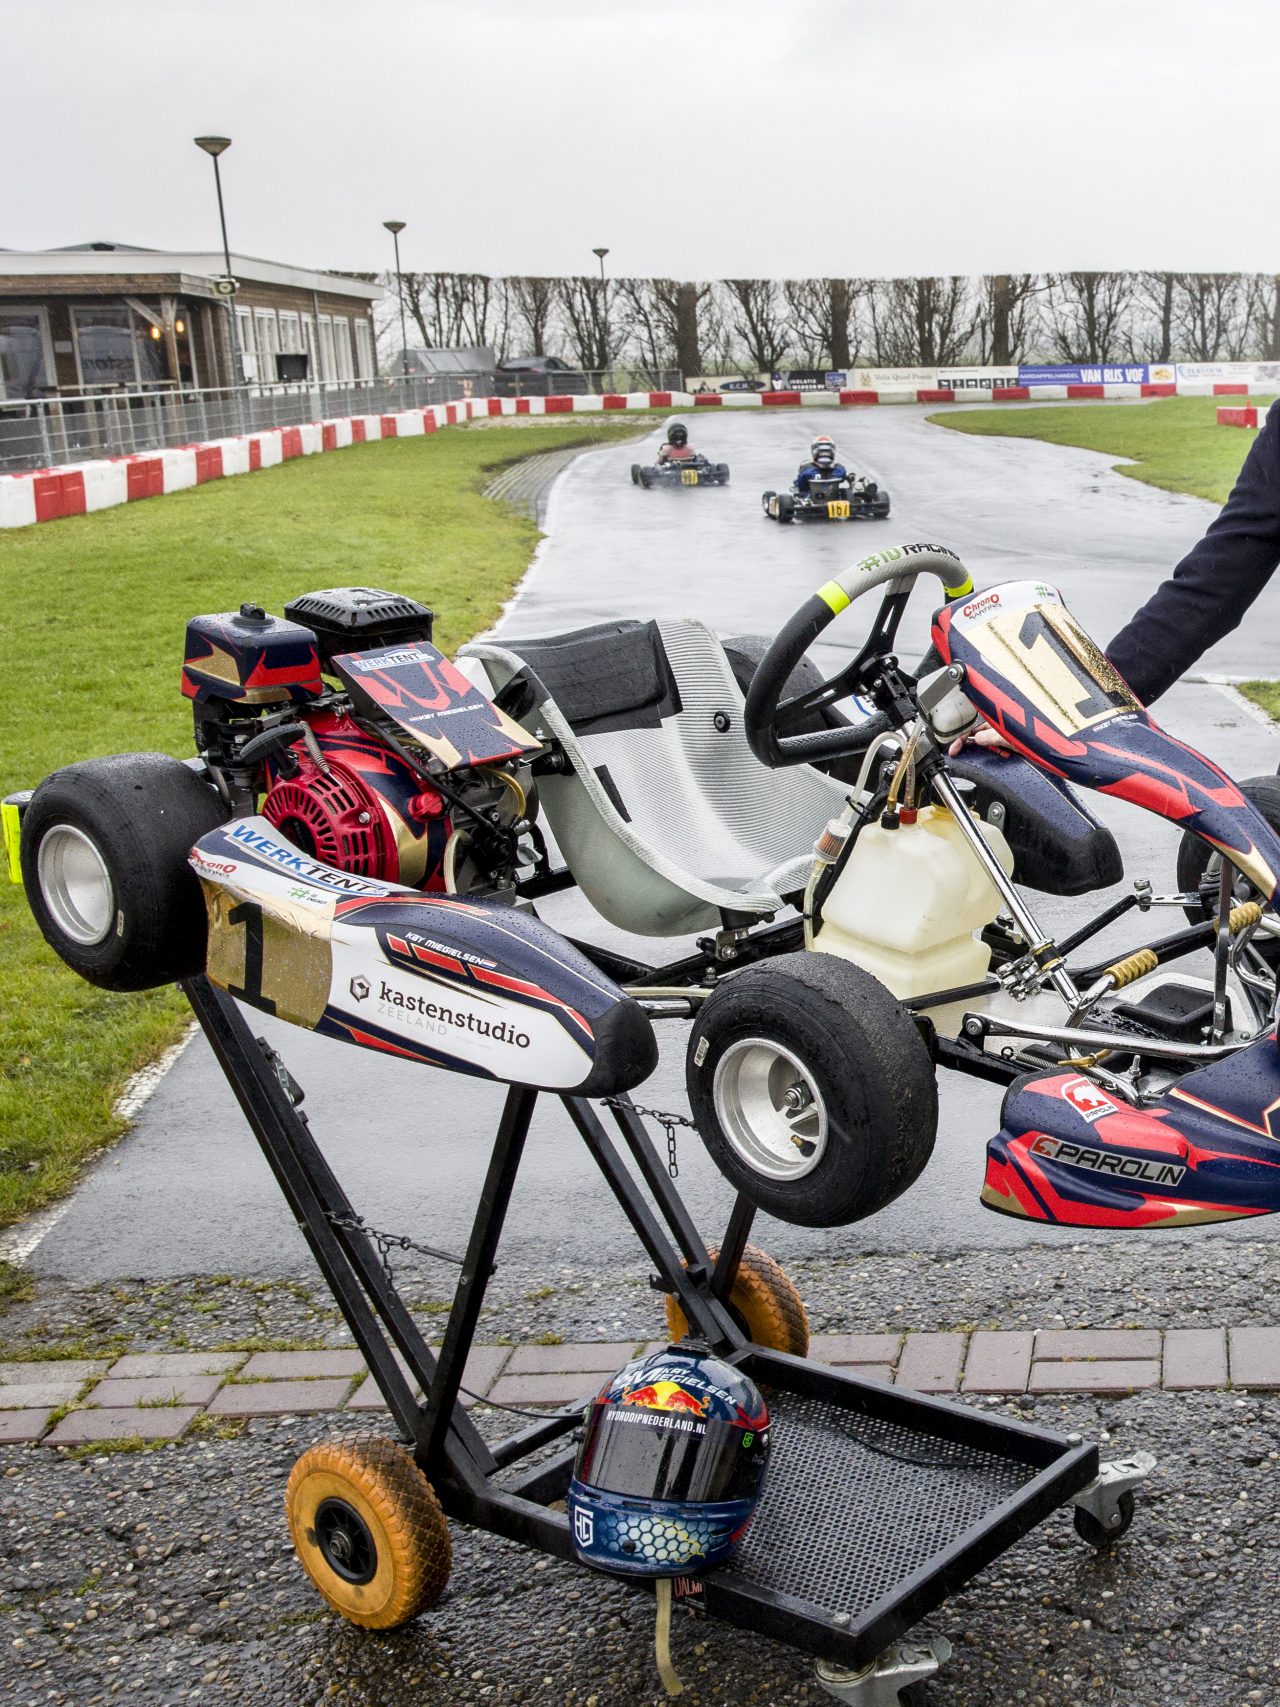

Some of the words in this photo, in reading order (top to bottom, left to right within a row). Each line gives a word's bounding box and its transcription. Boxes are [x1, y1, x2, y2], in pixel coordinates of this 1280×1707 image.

[1080, 369, 1100, 382] VAN
[1125, 368, 1144, 381] VOF
[830, 502, 849, 518] 167
[359, 653, 421, 670] WERKTENT
[1019, 611, 1129, 719] 1
[232, 824, 377, 892] WERKTENT
[228, 901, 277, 1016] 1
[405, 932, 426, 943] KAY
[425, 939, 484, 966] MIEGIELSEN
[377, 1003, 448, 1036] ZEELAND
[379, 981, 531, 1048] kastenstudio
[1085, 1105, 1114, 1120] PAROLIN
[1054, 1143, 1185, 1184] PAROLIN
[661, 1367, 691, 1376] KAY
[606, 1410, 707, 1435] HYDRODIPNEDERLAND.NL
